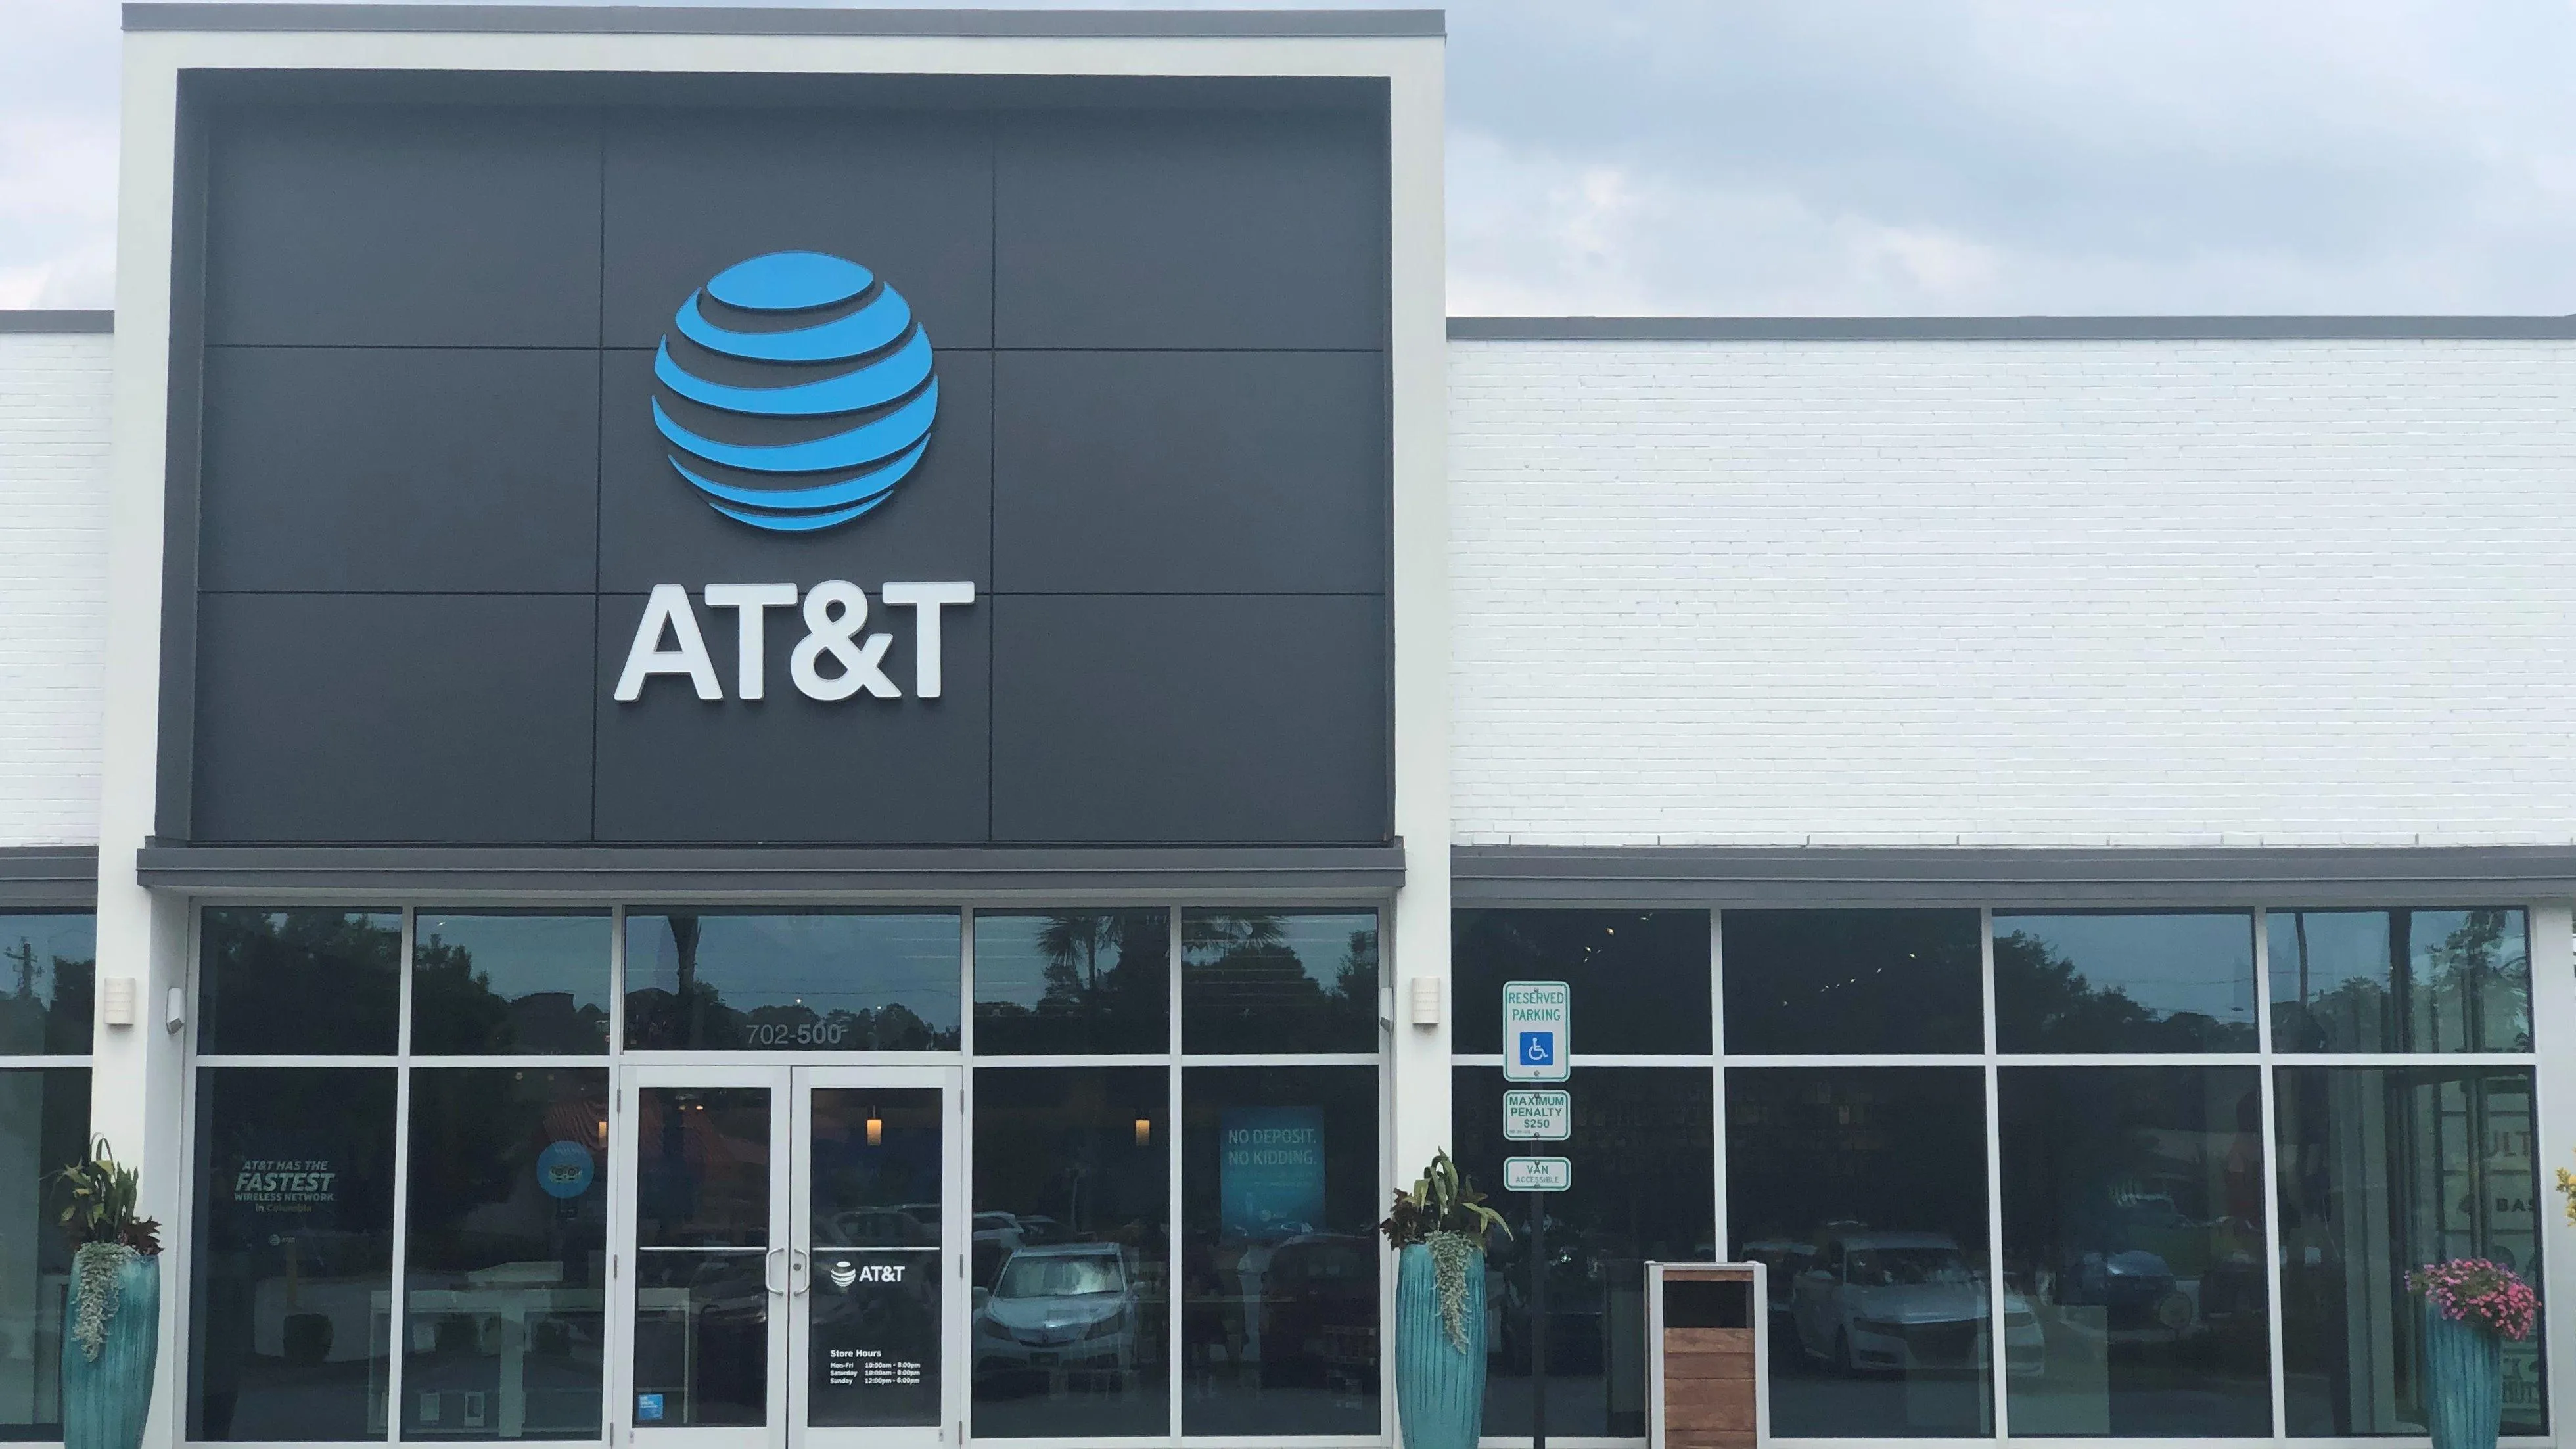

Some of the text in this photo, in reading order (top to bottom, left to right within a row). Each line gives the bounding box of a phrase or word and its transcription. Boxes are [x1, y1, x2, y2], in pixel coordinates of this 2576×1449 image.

[613, 580, 975, 701] AT&T
[1509, 992, 1564, 1004] RESERVED
[1512, 1009, 1561, 1021] PARKING
[746, 1024, 842, 1044] 702-500
[1509, 1096, 1564, 1106] MAXIMUM
[1511, 1107, 1562, 1117] PENALTY
[1524, 1118, 1550, 1128] $250
[1228, 1128, 1316, 1144] NO DEPOSIT.
[1228, 1150, 1317, 1166] NO KIDDING.
[242, 1161, 329, 1171] AT&T HAS THE
[1527, 1165, 1549, 1174] VAN
[235, 1172, 336, 1191] FASTEST
[235, 1193, 334, 1201] WIRELESS NETWORK
[858, 1265, 906, 1282] AT&T
[830, 1349, 881, 1358] Store Hours
